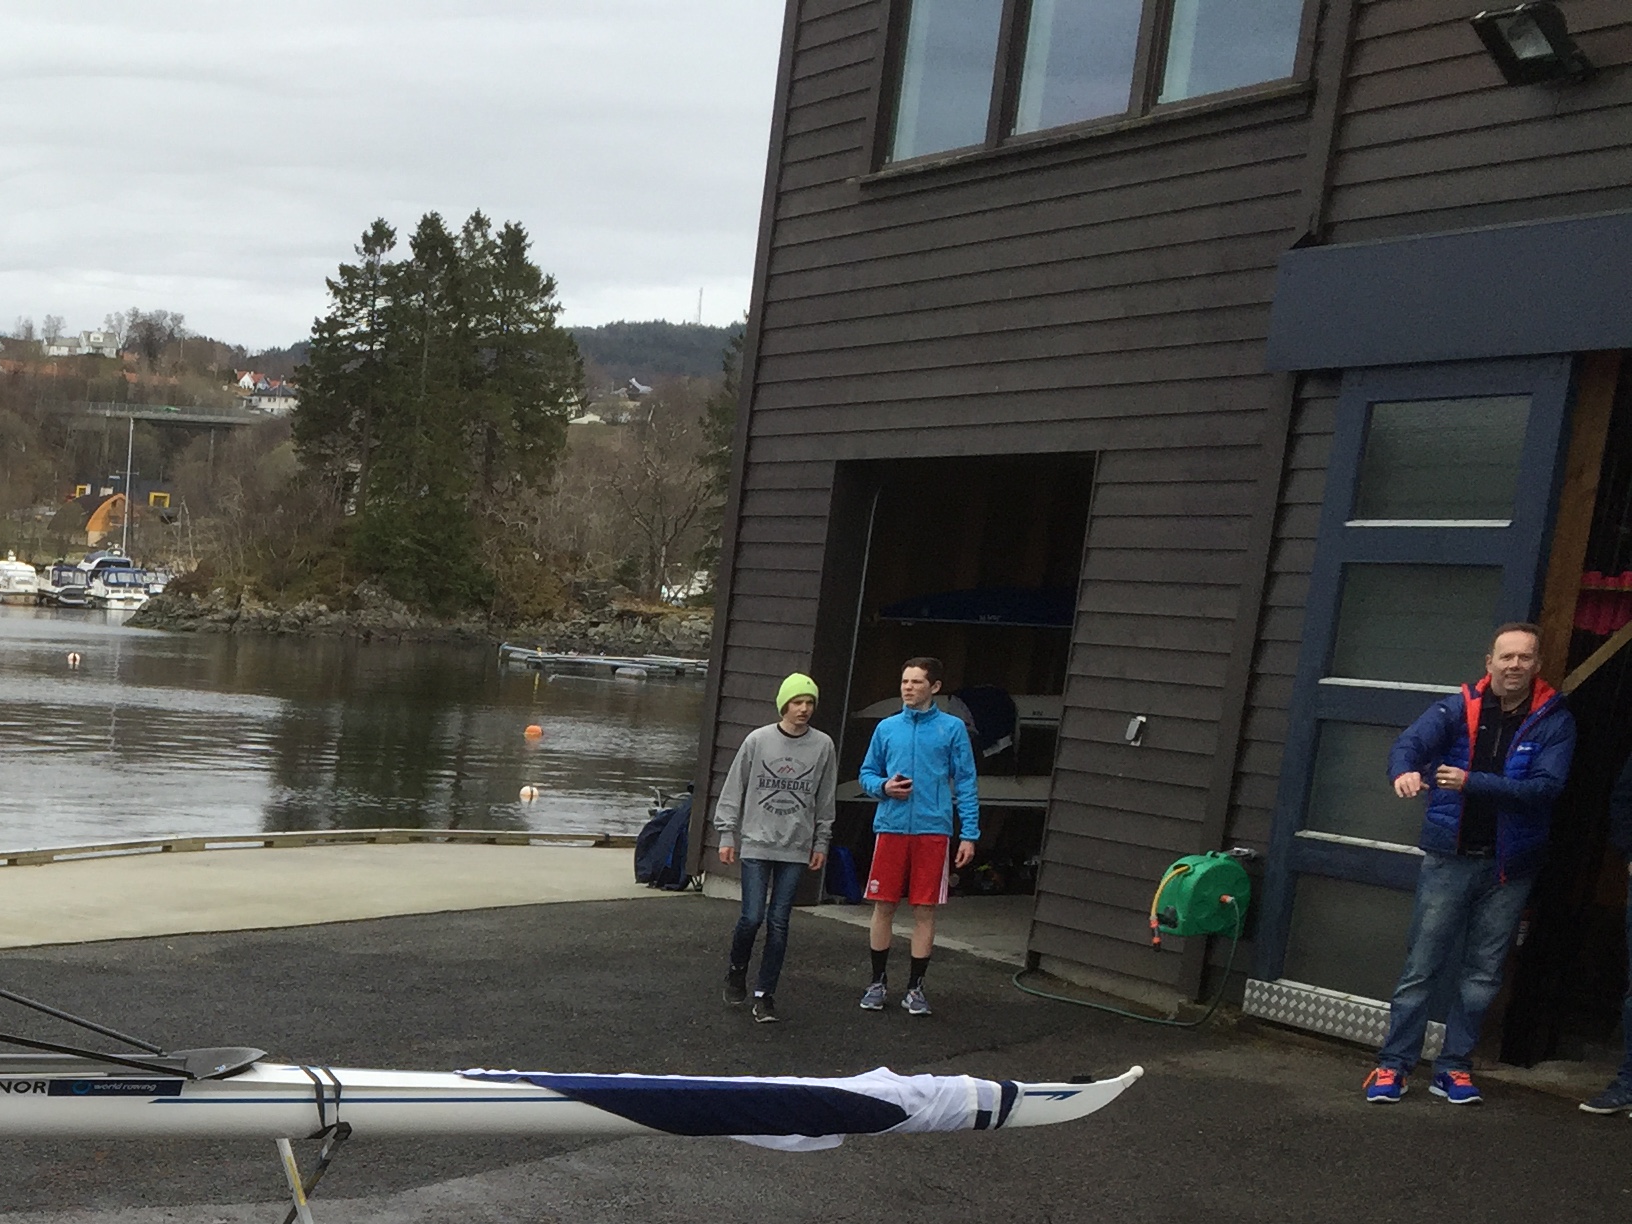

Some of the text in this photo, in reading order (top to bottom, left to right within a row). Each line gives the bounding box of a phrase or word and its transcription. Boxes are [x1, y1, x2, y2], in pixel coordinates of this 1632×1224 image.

[759, 778, 811, 791] HEMSEDAL
[94, 1082, 157, 1092] world rowing
